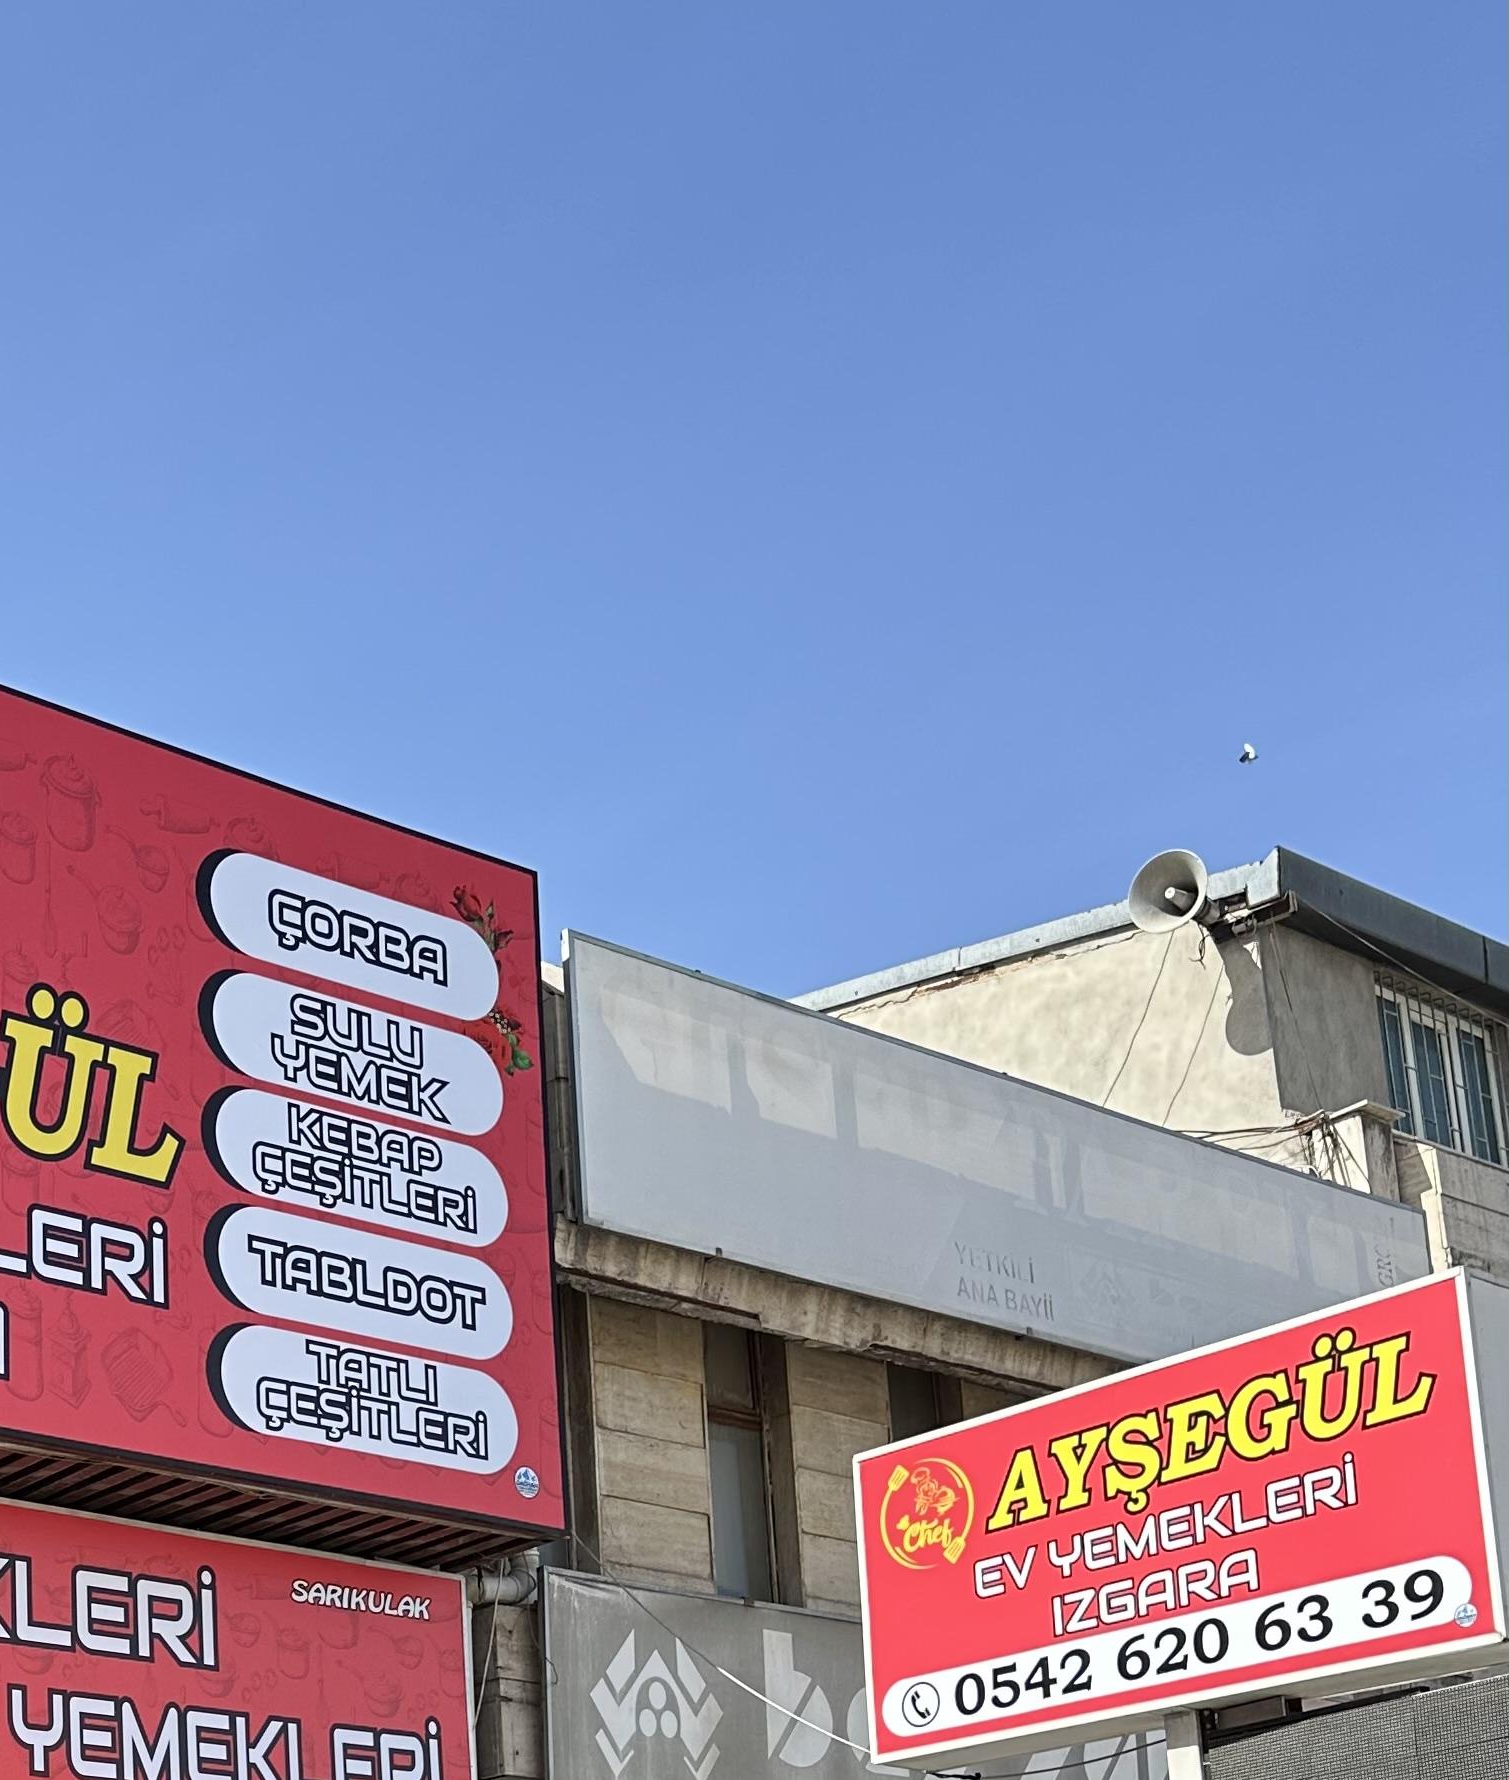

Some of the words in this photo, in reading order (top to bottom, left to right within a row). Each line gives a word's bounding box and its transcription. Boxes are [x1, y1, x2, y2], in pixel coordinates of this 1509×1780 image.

[268, 888, 448, 987] ÇORBA
[290, 994, 424, 1069] SULU
[271, 1033, 450, 1125] YEMEK
[288, 1103, 443, 1176] KEBAP
[252, 1142, 478, 1235] ÇEŞİTLERİ
[248, 1233, 486, 1330] TABLDOT
[957, 1276, 999, 1306] ANA
[306, 1339, 438, 1405] TATLI
[257, 1376, 488, 1461] ÇEŞİTLERİ
[985, 1327, 1437, 1533] AYŞEGÜL
[902, 1511, 955, 1553] Chef
[973, 1543, 1037, 1599] EV
[1048, 1452, 1360, 1579] YEMEKLERİ
[289, 1577, 431, 1620] SARIKULAK
[1050, 1548, 1259, 1639] IZGARA
[954, 1648, 1093, 1716] 0542
[1117, 1617, 1229, 1681] 620
[1253, 1594, 1333, 1652] 63
[1361, 1567, 1445, 1627] 39
